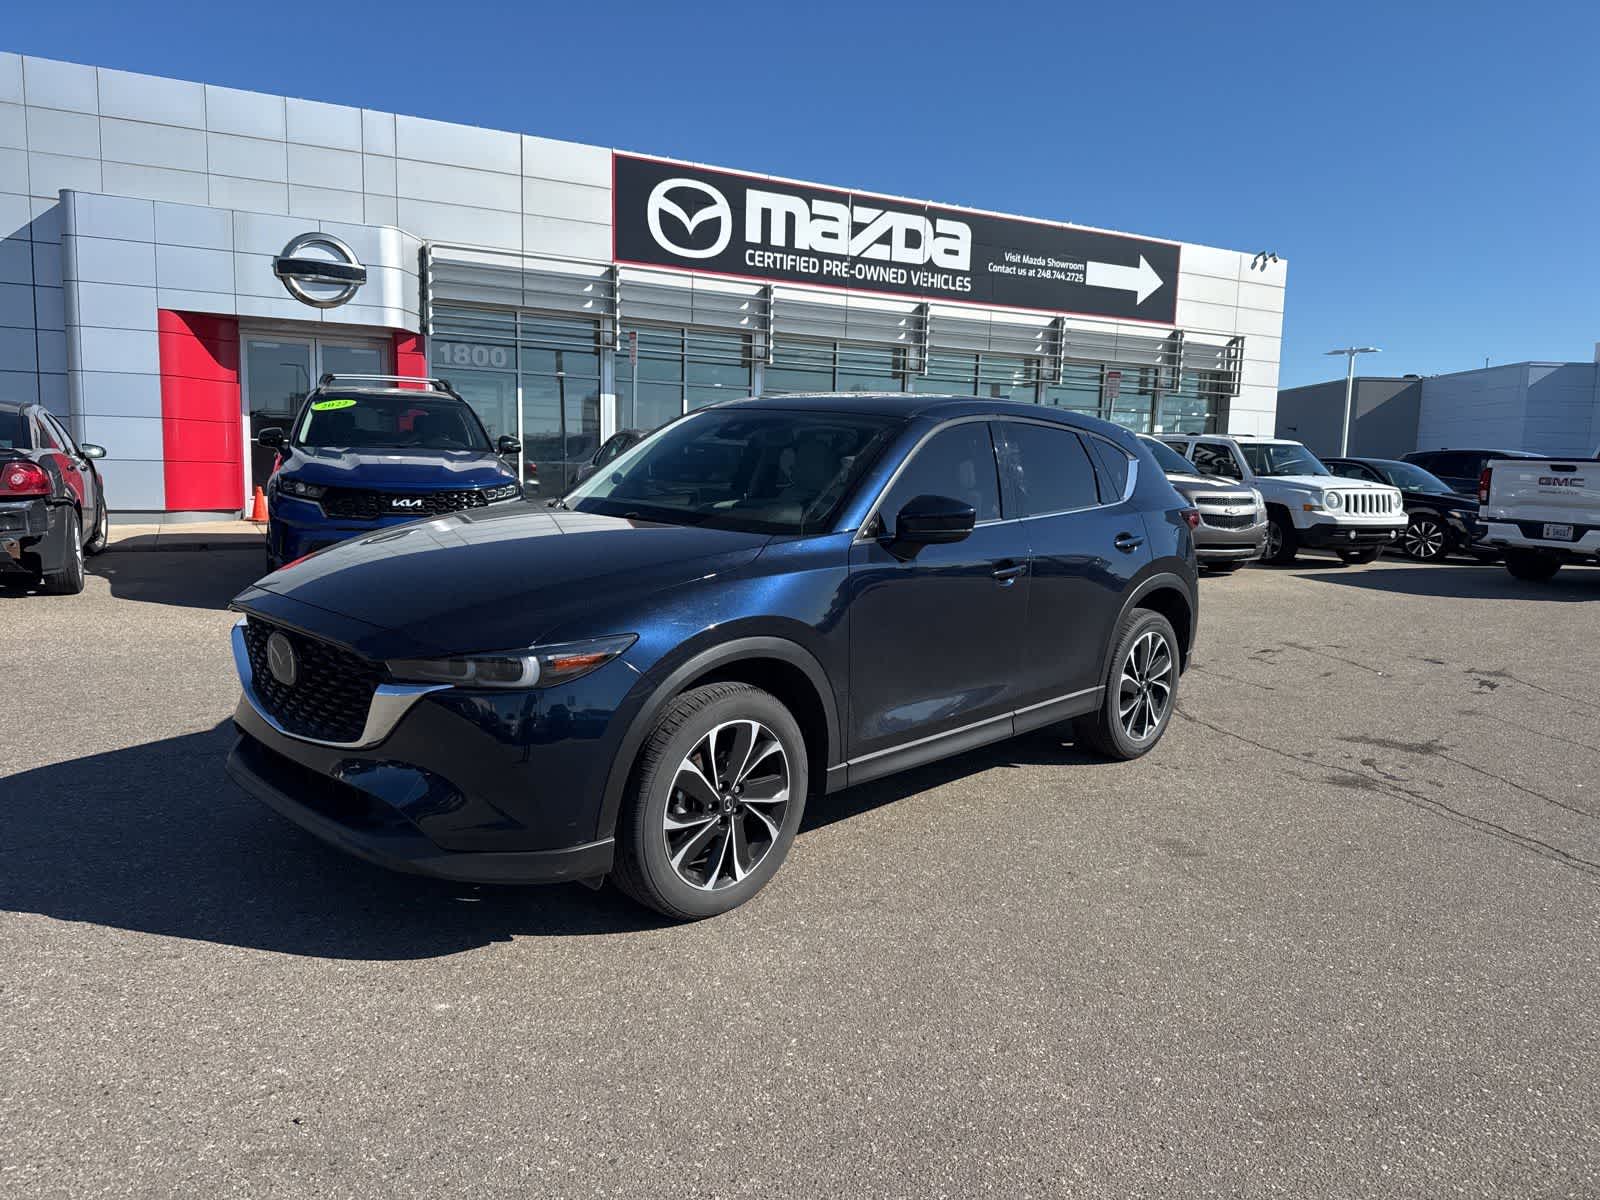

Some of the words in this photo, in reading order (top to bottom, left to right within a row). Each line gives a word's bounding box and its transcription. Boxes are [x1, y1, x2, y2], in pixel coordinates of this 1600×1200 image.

[745, 249, 820, 274] CERTIFIED
[823, 260, 907, 285] PRE-OWNED
[910, 270, 972, 292] VEHICLES
[1004, 251, 1021, 263] Visit
[1022, 254, 1046, 266] Mazda
[1047, 257, 1085, 271] Showroom
[988, 262, 1016, 275] Contact
[1017, 267, 1027, 276] us
[1028, 268, 1036, 277] at
[1036, 268, 1084, 283] 248.744.2725
[439, 343, 507, 368] 1800
[1539, 476, 1585, 488] GMC
